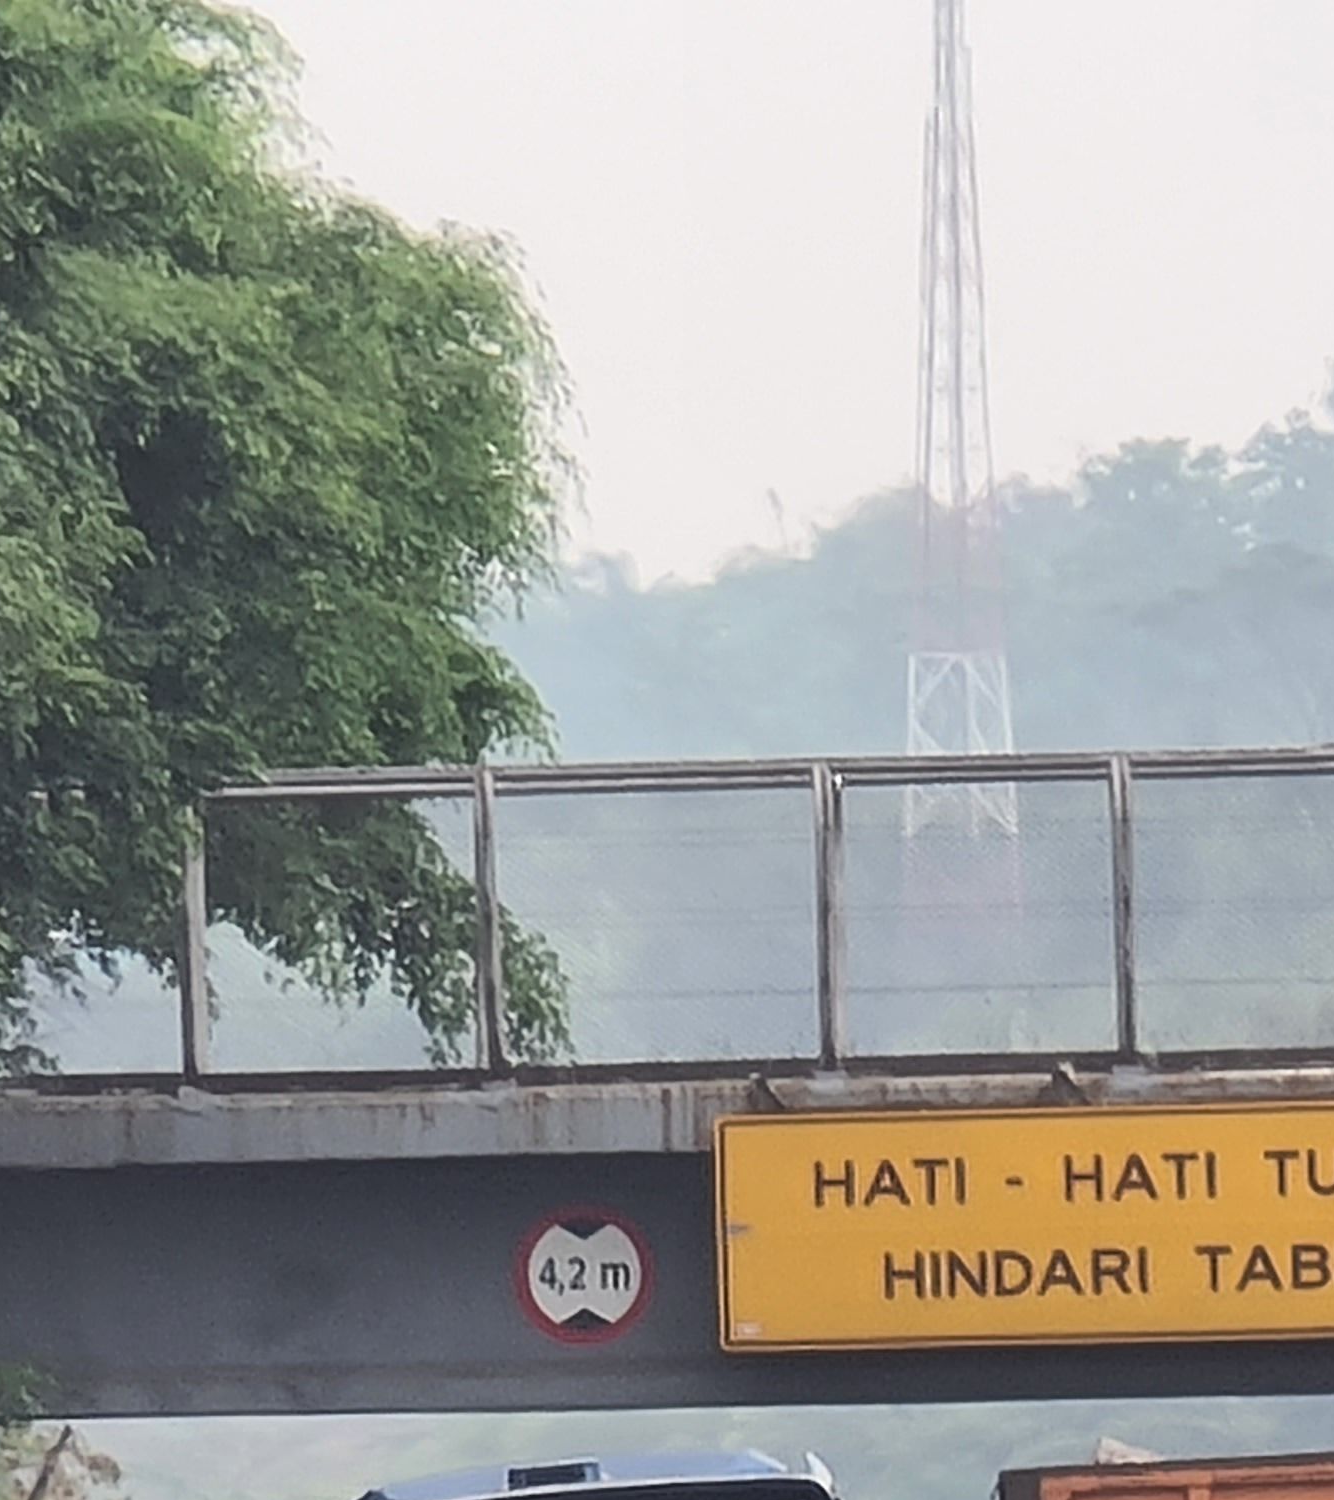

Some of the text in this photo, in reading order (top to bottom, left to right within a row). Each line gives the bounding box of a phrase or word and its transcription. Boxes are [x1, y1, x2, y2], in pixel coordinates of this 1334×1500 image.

[813, 1157, 967, 1208] HATI
[1063, 1151, 1218, 1201] HATI
[538, 1256, 631, 1297] 4,2 m
[883, 1245, 1150, 1301] HINDARI
